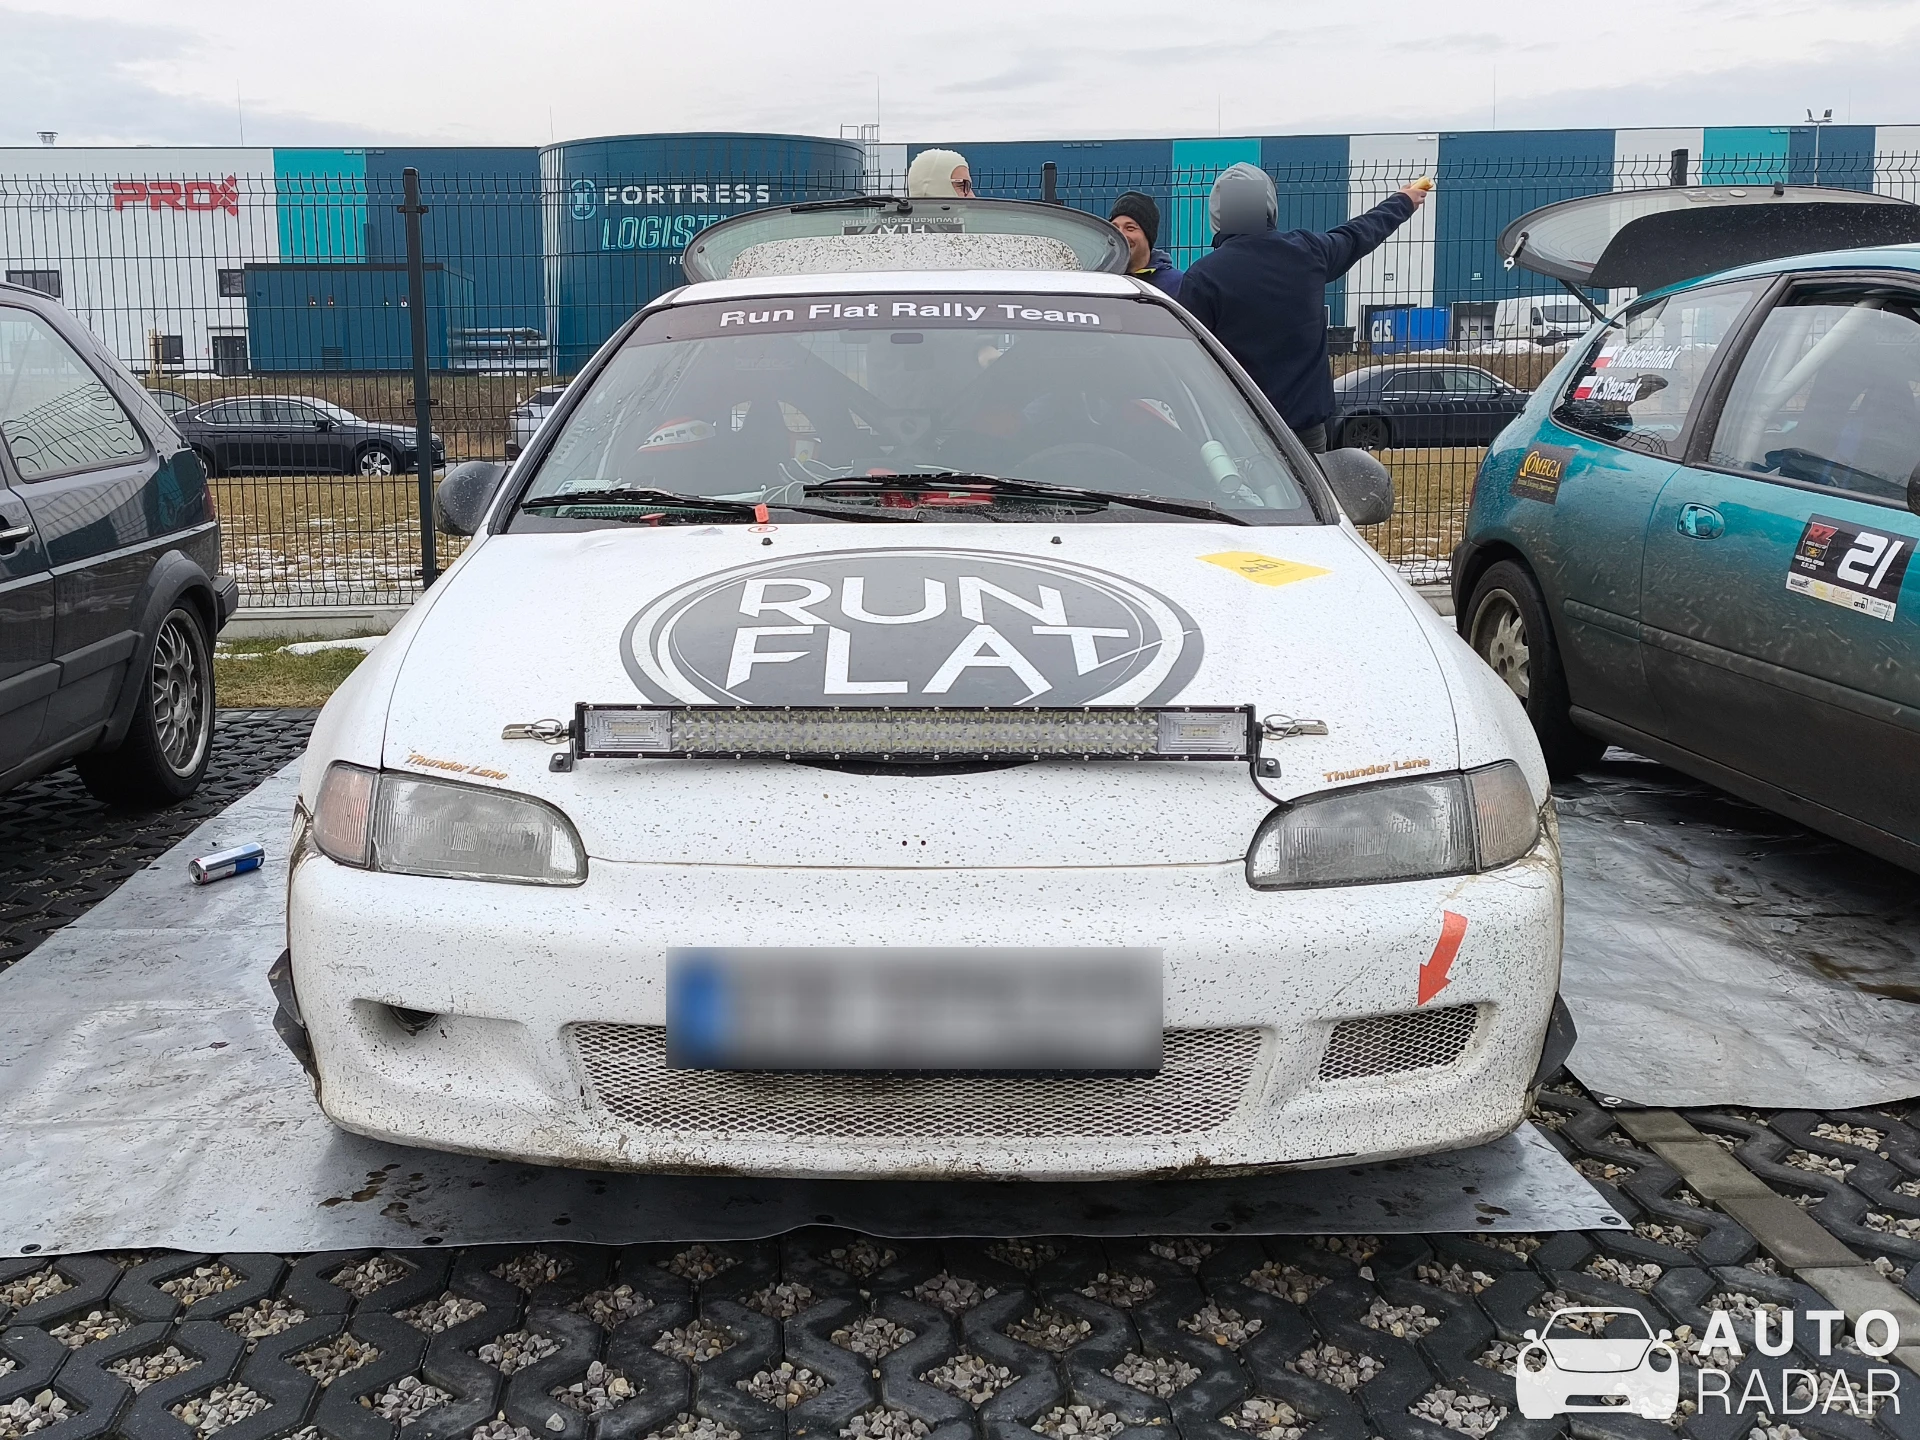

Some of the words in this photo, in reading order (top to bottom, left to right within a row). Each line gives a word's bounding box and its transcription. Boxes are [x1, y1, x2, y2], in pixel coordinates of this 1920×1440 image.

[605, 184, 770, 206] FORTRESS
[719, 310, 794, 327] Run
[808, 303, 879, 319] Flat
[891, 302, 986, 321] Rally
[997, 304, 1101, 325] Team
[1837, 531, 1905, 590] 21
[738, 576, 1069, 625] RUN
[725, 623, 1131, 697] FLAT
[405, 754, 470, 773] Thunder
[466, 765, 508, 780] Lane
[1323, 764, 1391, 783] Thunder
[1393, 758, 1431, 772] Lane
